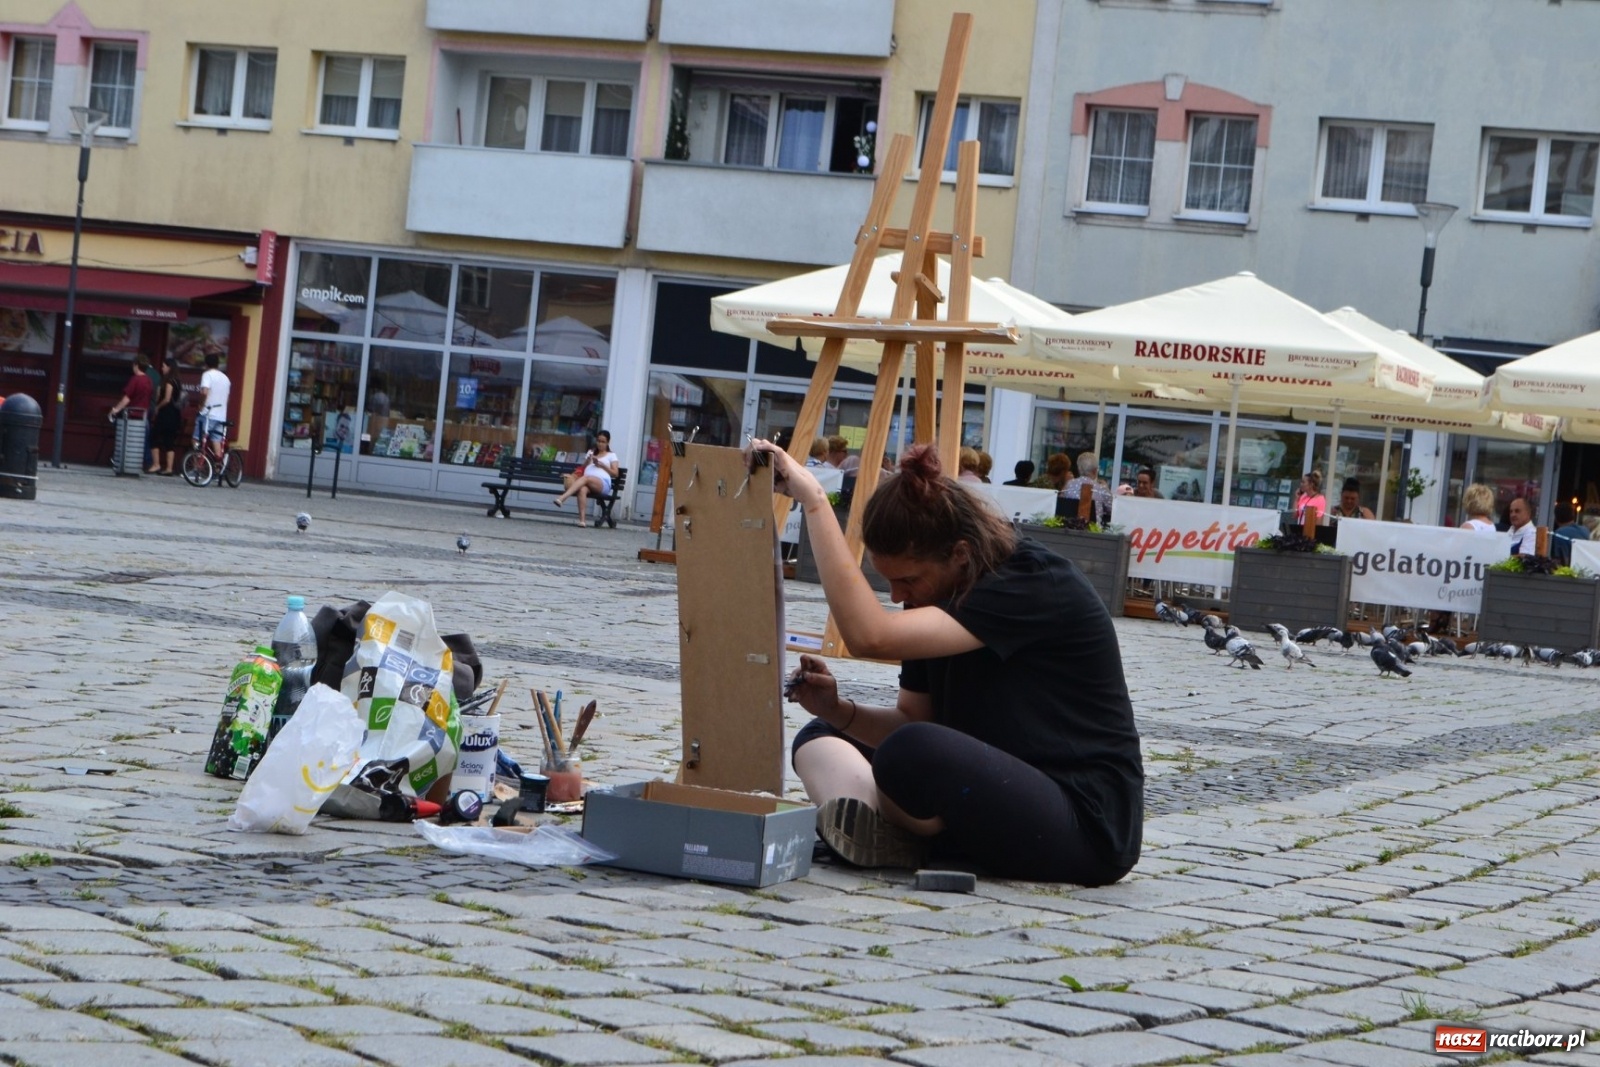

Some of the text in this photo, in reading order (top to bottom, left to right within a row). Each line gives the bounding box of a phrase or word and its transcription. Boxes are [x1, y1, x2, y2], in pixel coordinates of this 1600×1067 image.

[301, 285, 365, 303] empik.com
[1045, 337, 1113, 349] BROWAR ZAMKOWY
[1134, 340, 1266, 366] RACIBORSKIE
[1288, 354, 1319, 363] BROWAR
[1320, 356, 1359, 368] ZAMKOWY
[1513, 379, 1545, 388] BROWAR
[1546, 381, 1586, 393] ZAMKOWY
[464, 734, 492, 747] ulux
